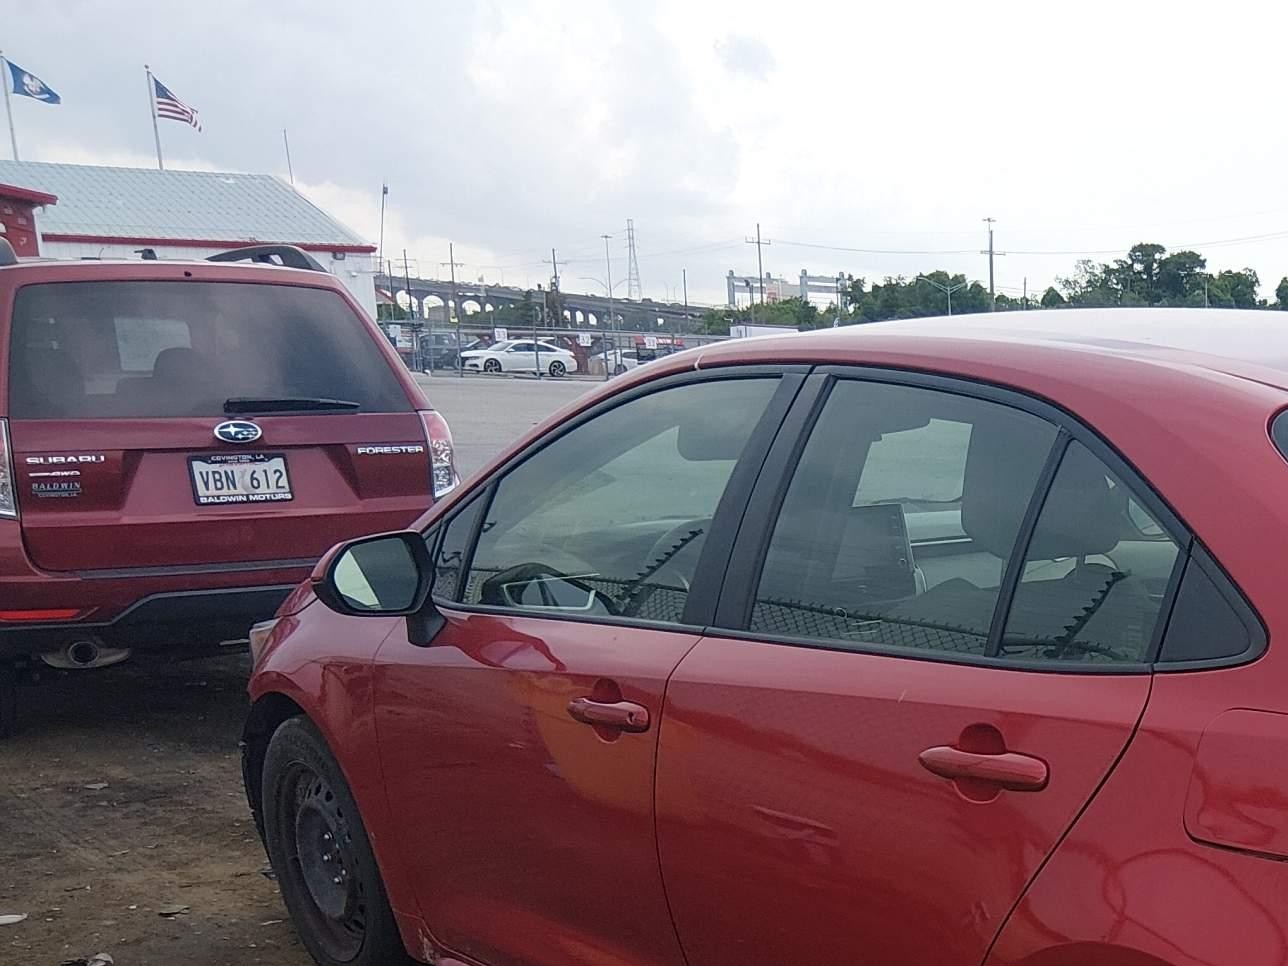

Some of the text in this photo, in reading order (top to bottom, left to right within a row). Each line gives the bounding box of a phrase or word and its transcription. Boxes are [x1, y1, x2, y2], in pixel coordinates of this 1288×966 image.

[357, 446, 424, 454] FORESTER
[26, 455, 105, 464] SUBARU
[199, 469, 285, 491] VBN 612
[32, 482, 80, 490] BALDWIN
[200, 493, 292, 503] BALDWIN MOTORS
